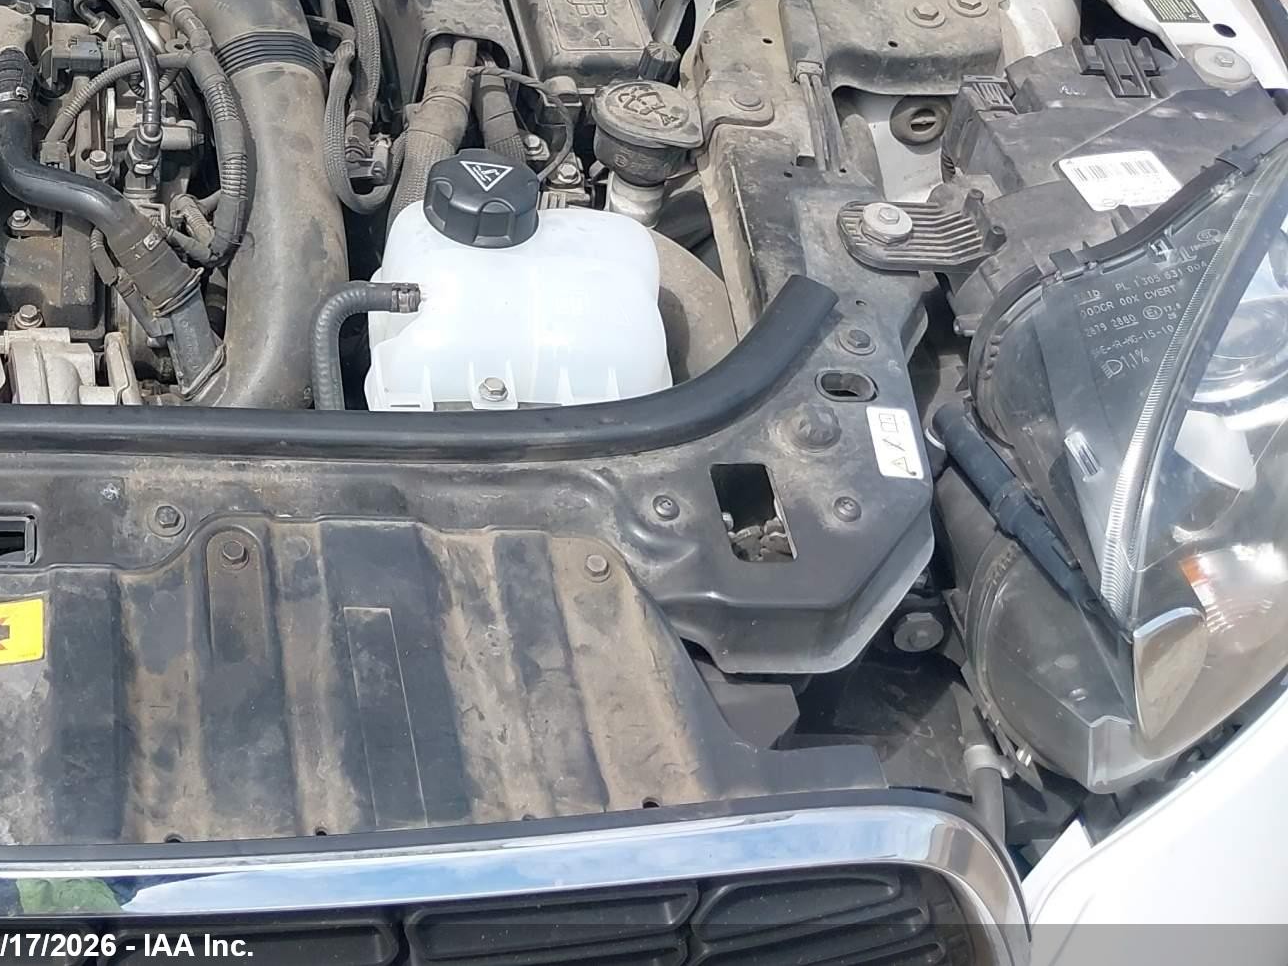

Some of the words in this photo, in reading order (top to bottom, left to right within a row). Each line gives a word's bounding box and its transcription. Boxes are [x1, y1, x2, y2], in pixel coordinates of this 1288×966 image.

[1142, 271, 1161, 285] 305
[1164, 268, 1183, 281] 631
[1143, 285, 1177, 300] CVERT
